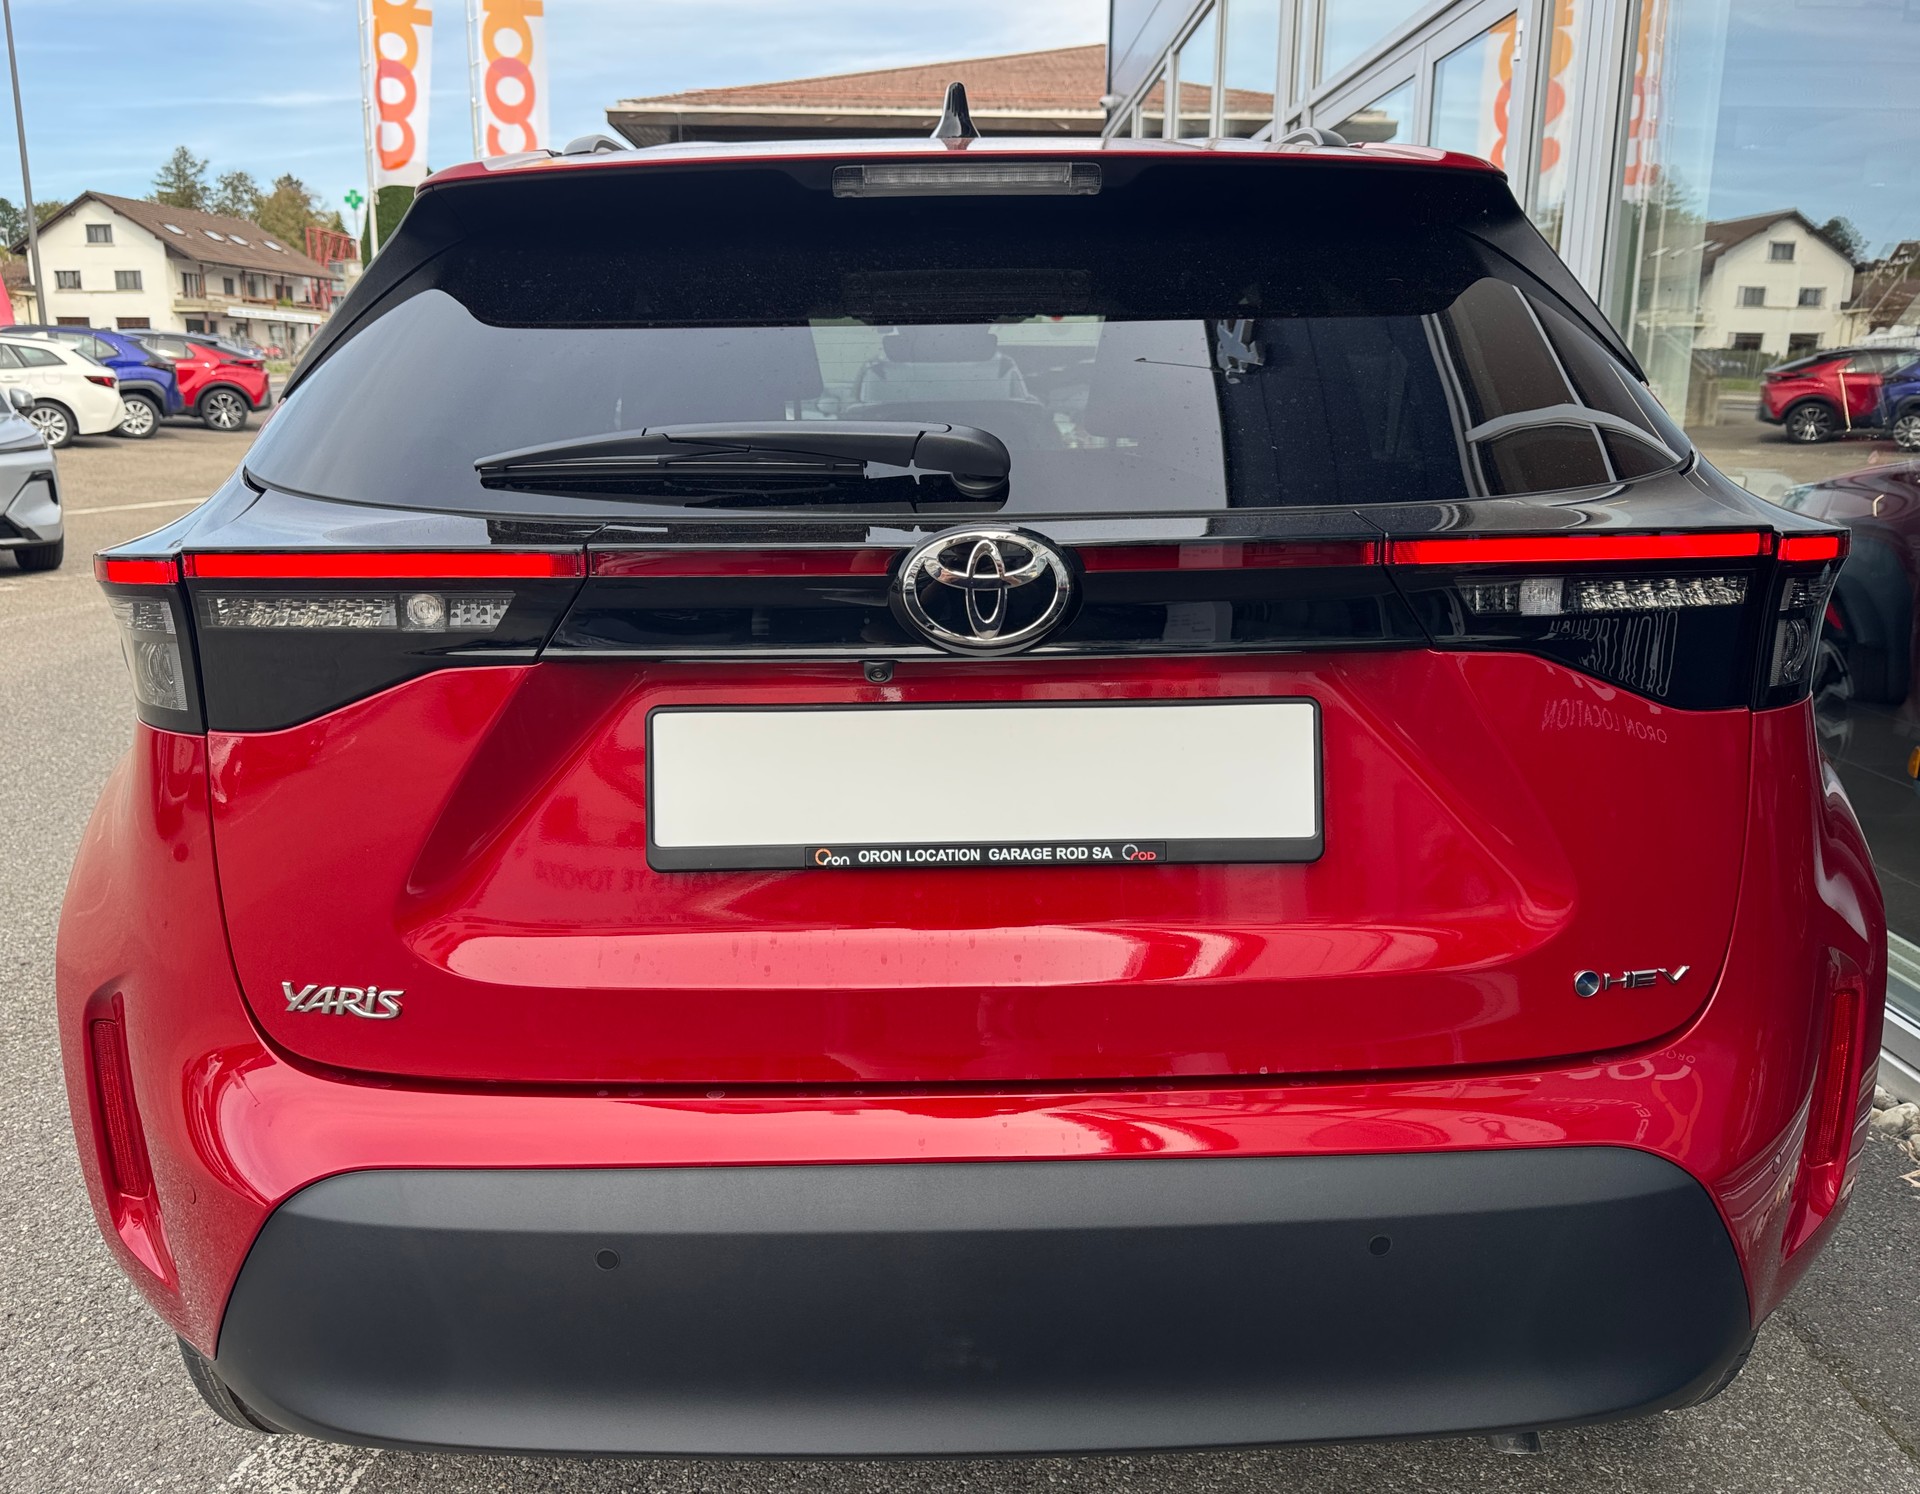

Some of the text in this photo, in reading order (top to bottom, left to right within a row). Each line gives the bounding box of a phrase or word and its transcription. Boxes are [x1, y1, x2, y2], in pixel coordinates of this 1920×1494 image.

[858, 846, 1113, 863] ORON LOCATION GARAGE ROD SA
[1603, 965, 1690, 990] HEV
